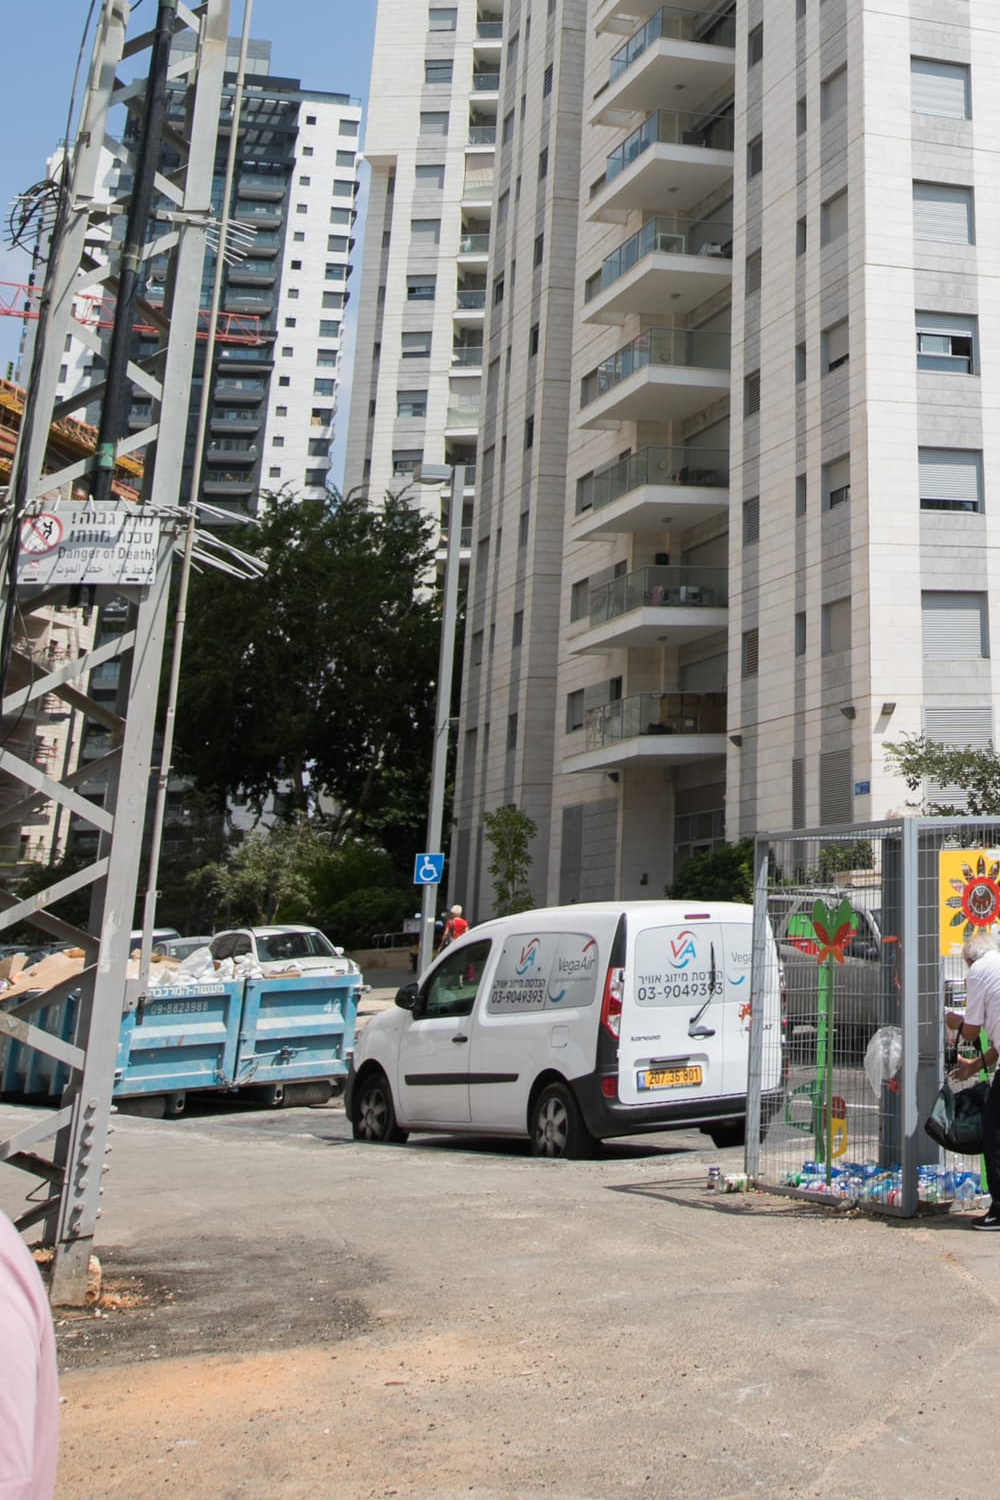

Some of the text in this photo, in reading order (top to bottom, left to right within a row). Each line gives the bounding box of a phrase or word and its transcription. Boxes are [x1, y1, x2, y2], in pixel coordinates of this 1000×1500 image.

[71, 511, 115, 525] גבוה!
[69, 530, 111, 543] מוות!
[58, 546, 155, 562] Danger of Death!
[691, 970, 723, 981] הדסת
[492, 990, 544, 1004] 03-9049393
[637, 982, 723, 1001] 03-9049393
[323, 998, 341, 1013] 42
